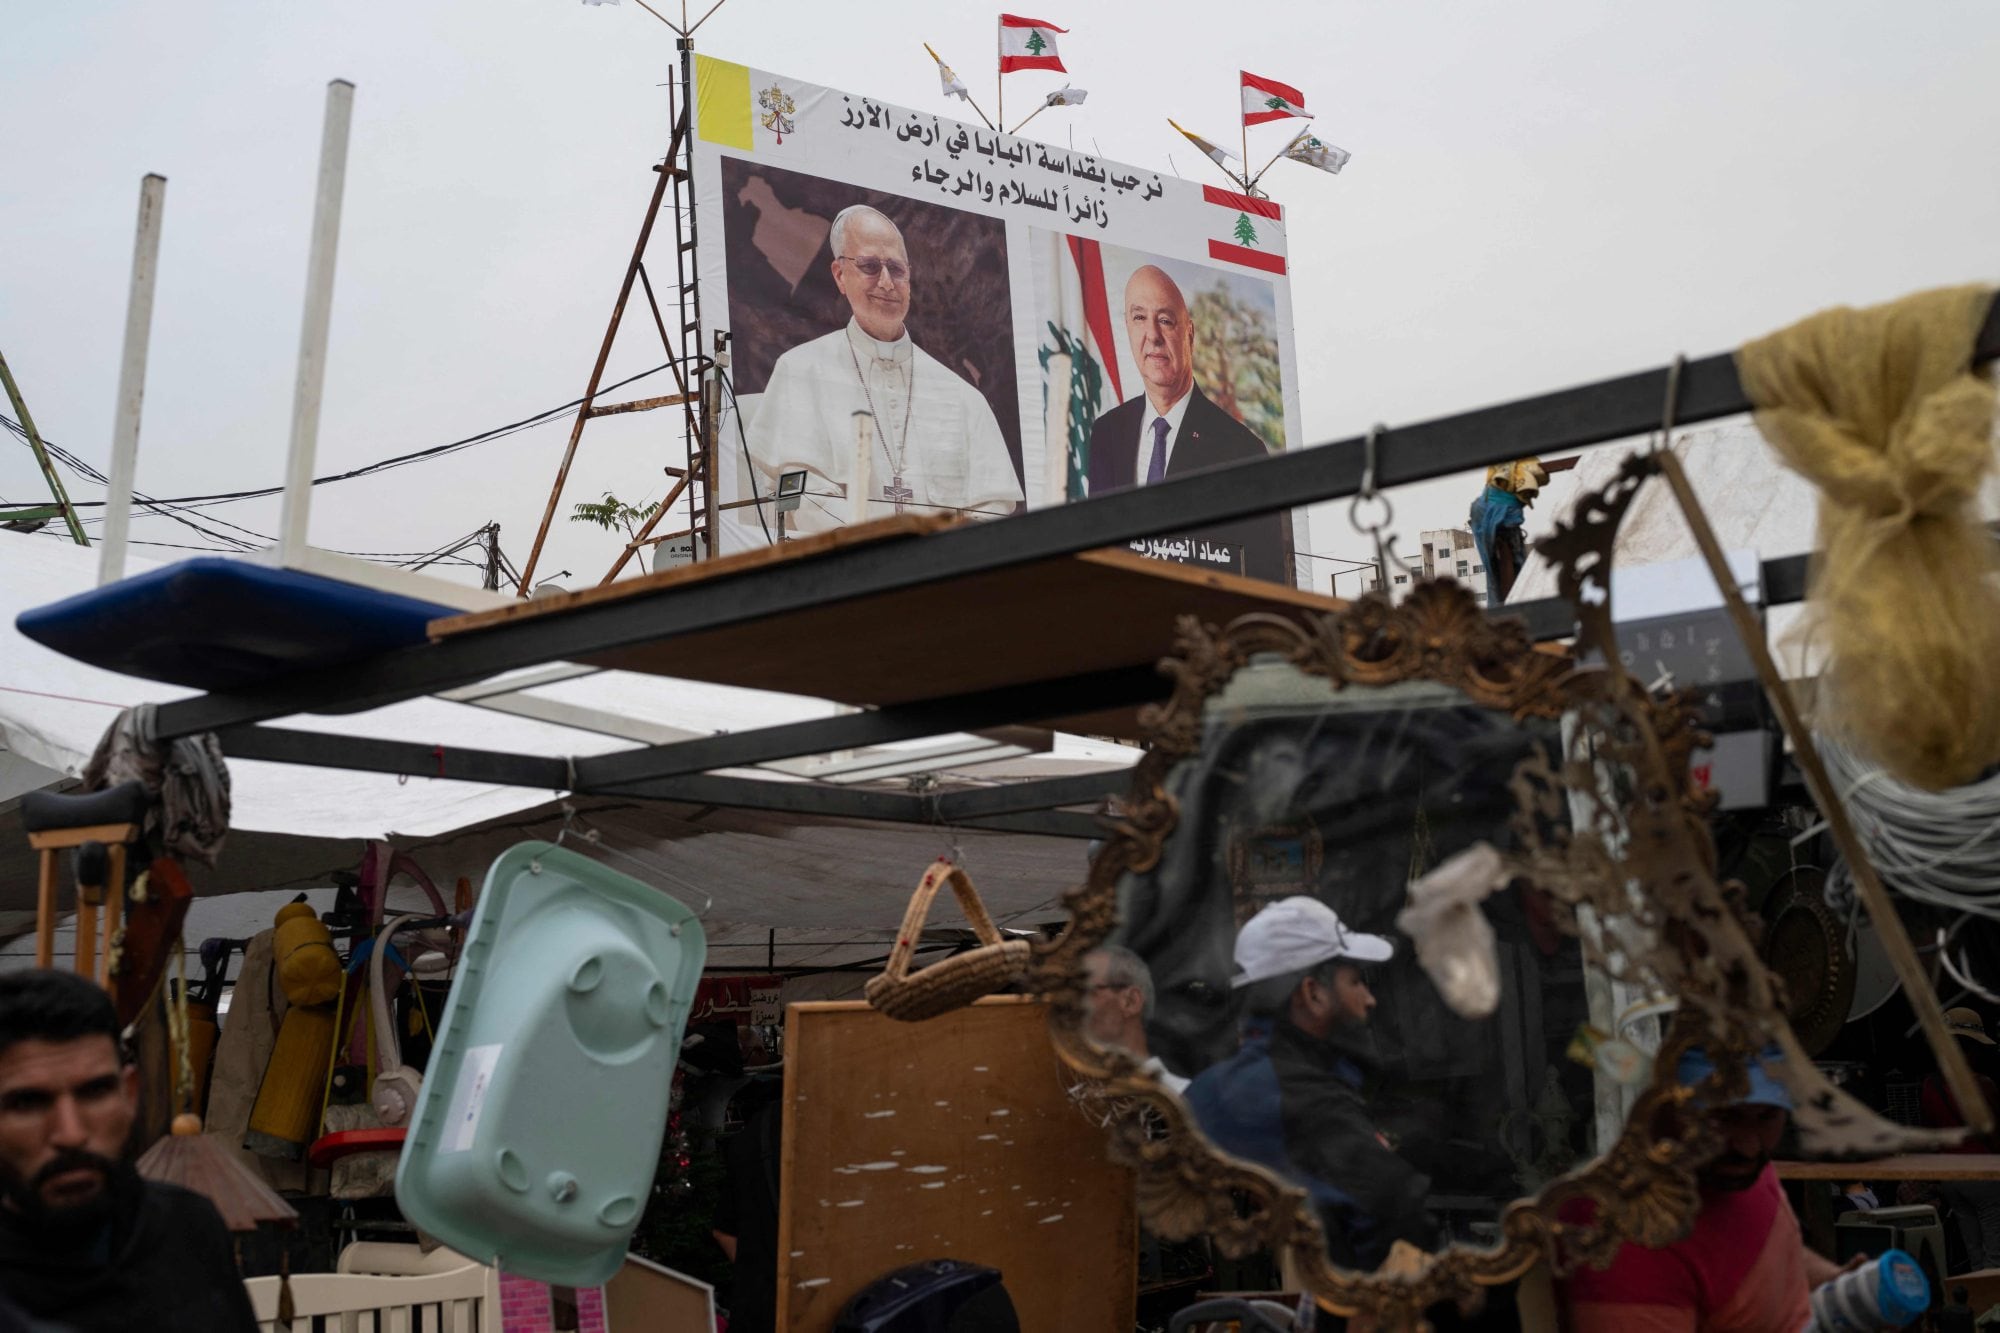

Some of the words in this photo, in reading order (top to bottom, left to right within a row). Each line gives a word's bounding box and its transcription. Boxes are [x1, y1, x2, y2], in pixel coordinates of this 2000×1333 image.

[840, 96, 890, 130] الأرز
[896, 114, 940, 146] أرض
[946, 124, 969, 160] في
[974, 130, 1032, 169] البابا
[912, 158, 994, 203] والرجاء
[1035, 142, 1106, 192] بقداسة
[998, 178, 1059, 211] للسلام
[1110, 171, 1163, 201] نرحب
[1199, 541, 1231, 563] عماد
[692, 983, 752, 1019] طور
